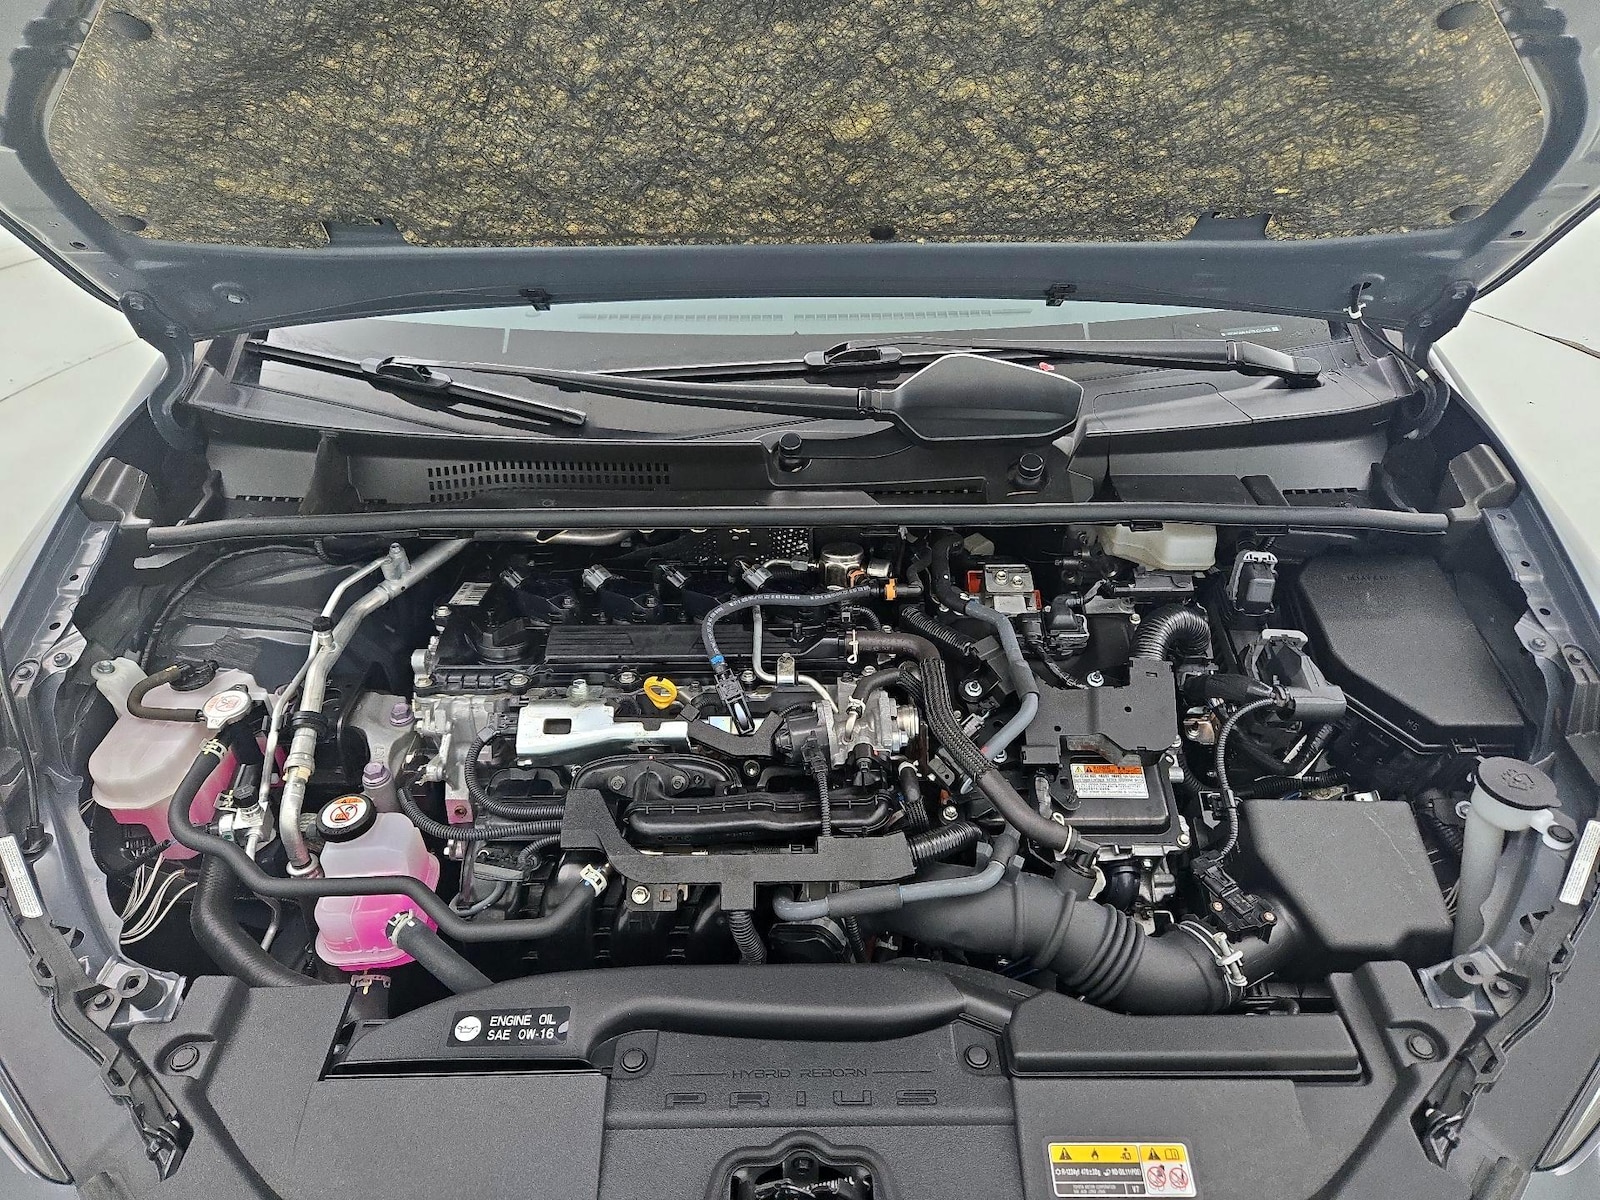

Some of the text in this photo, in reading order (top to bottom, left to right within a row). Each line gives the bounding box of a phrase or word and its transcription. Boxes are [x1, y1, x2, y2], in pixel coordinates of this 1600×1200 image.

[489, 1013, 557, 1027] ENGINE OIL
[486, 1028, 555, 1041] SAE 0W-16
[732, 1067, 868, 1079] HYBRID REBORN
[665, 1089, 938, 1109] PRIUS
